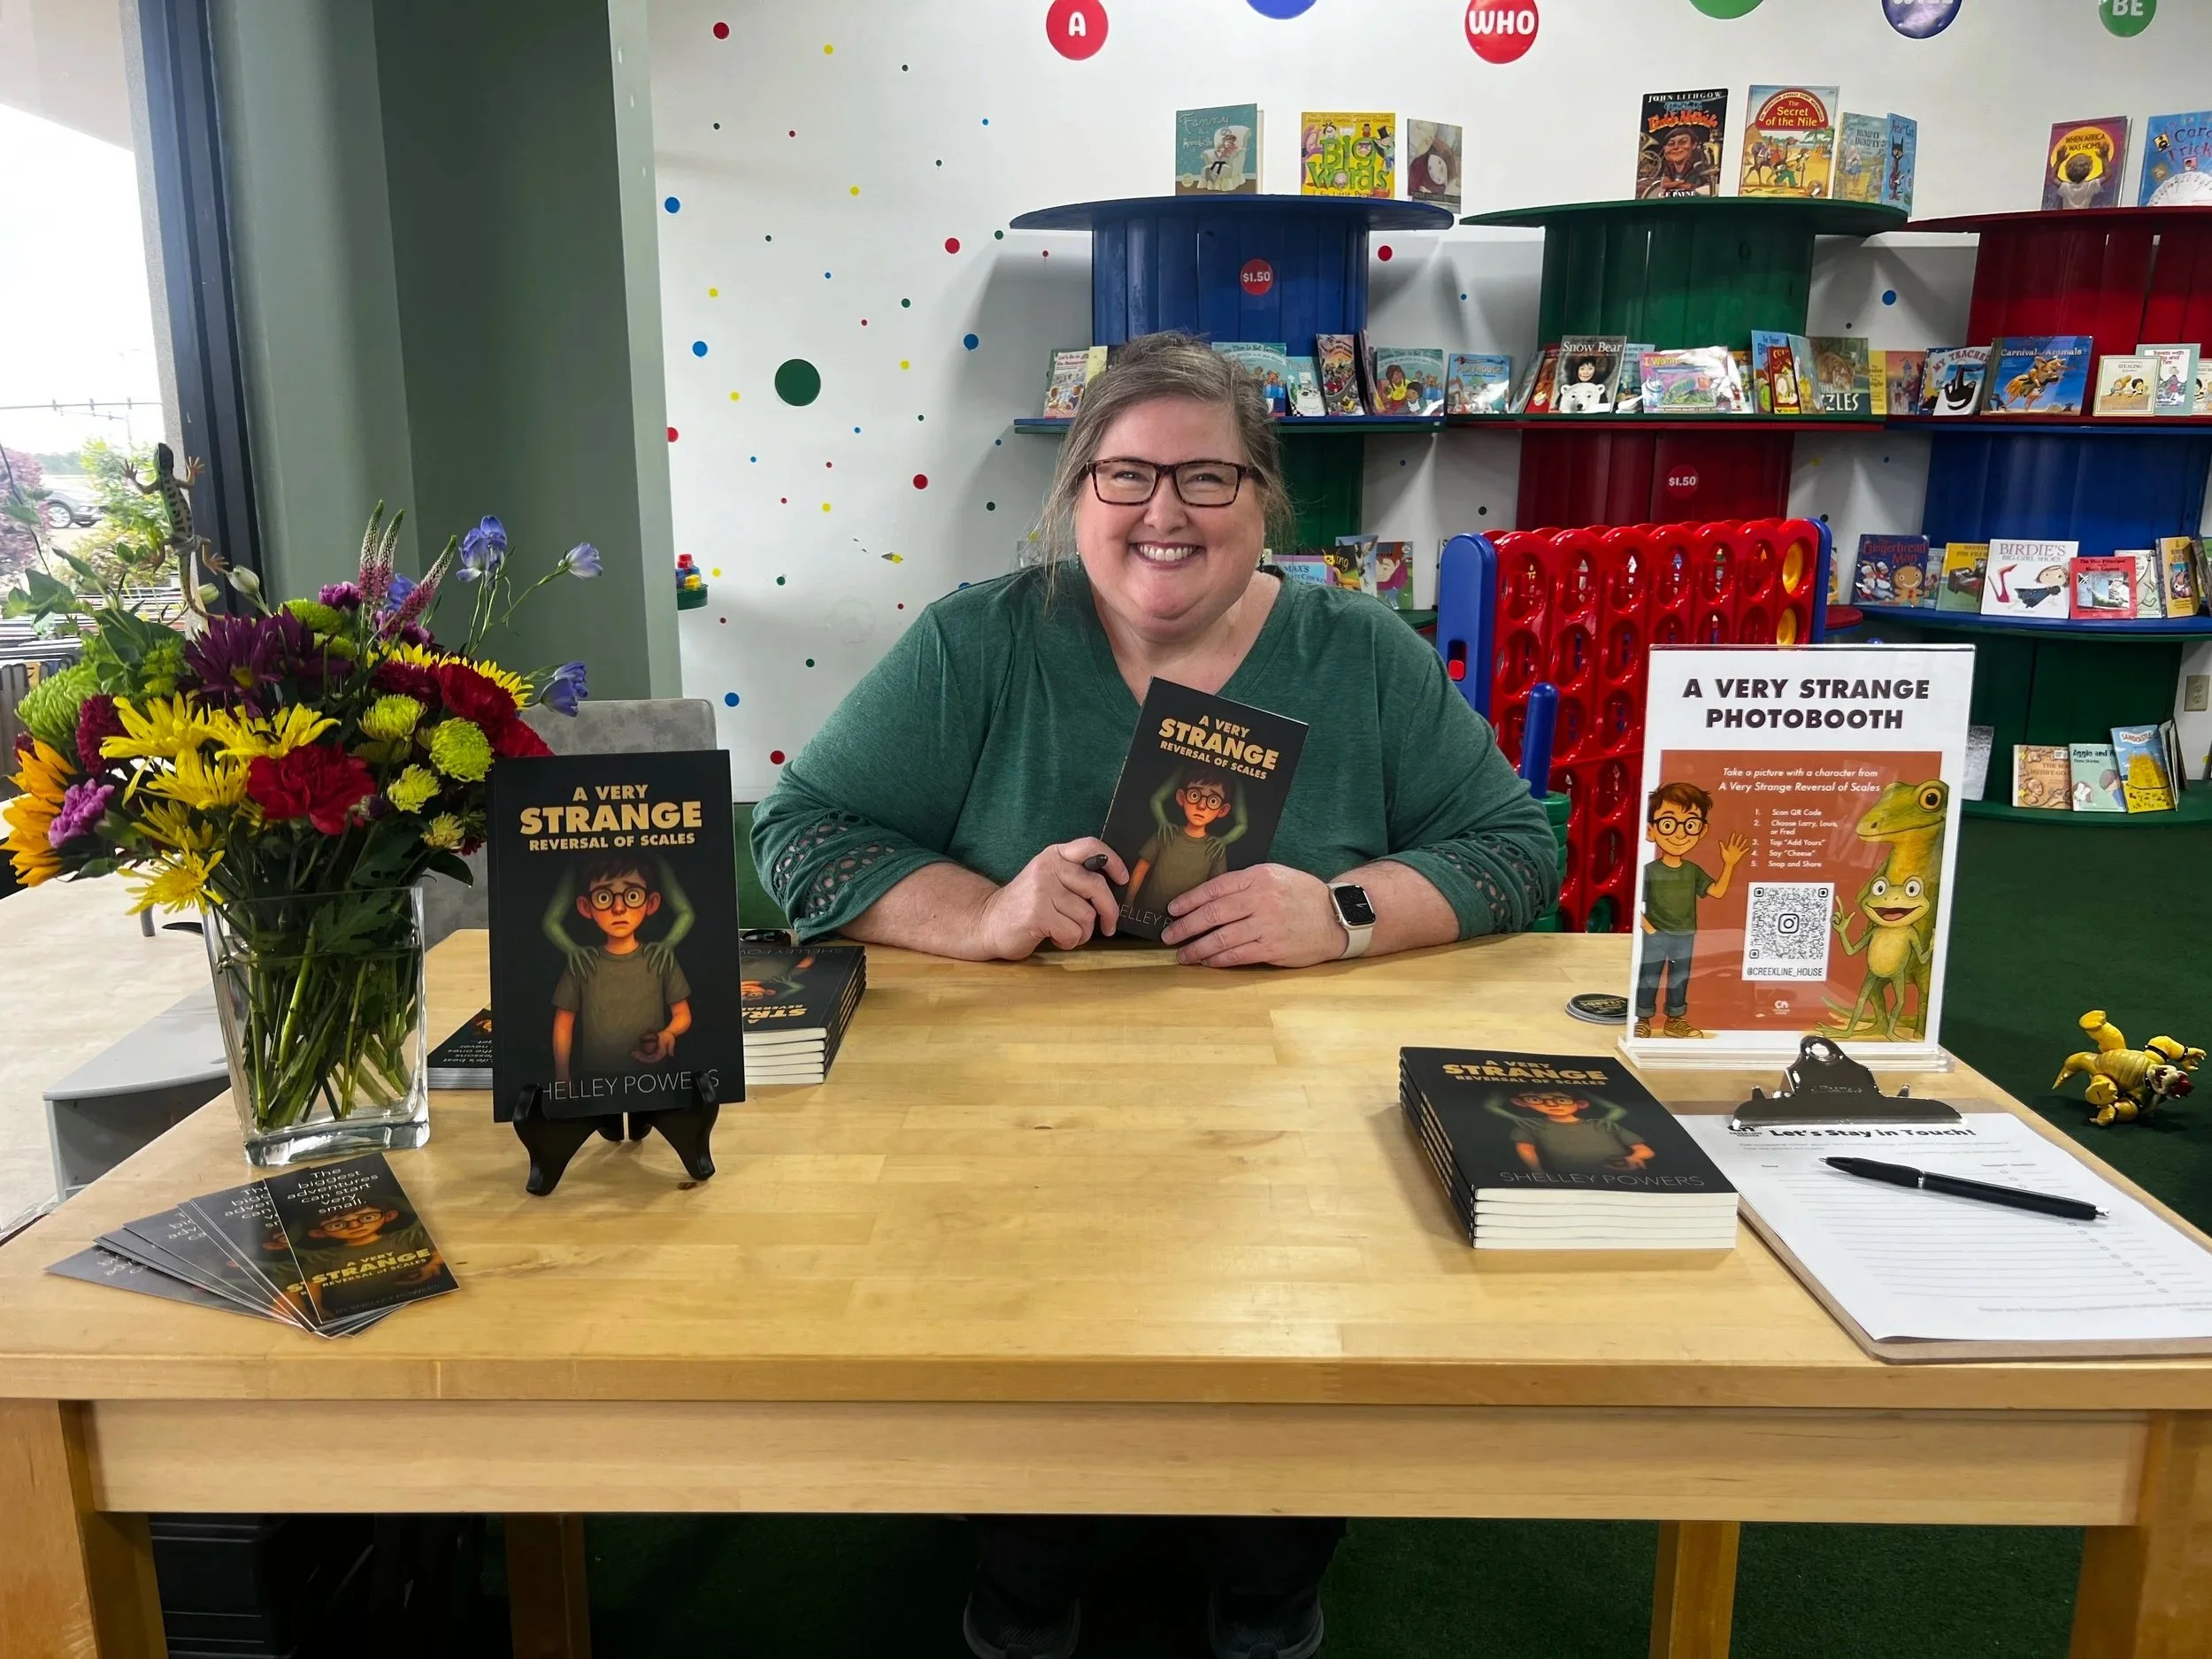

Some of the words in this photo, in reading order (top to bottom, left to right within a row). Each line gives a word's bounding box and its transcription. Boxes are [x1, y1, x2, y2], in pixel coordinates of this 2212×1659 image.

[2112, 0, 2144, 16] BE
[1068, 12, 1087, 37] A
[1469, 10, 1535, 35] WHO
[1677, 91, 1723, 101] LITHGOW
[1777, 106, 1809, 117] Secret
[1179, 112, 1230, 134] Fanny
[1765, 117, 1777, 127] of
[1778, 117, 1795, 127] the
[1797, 118, 1817, 127] Nile
[2065, 134, 2084, 143] WHEN
[2085, 133, 2106, 142] AFRICA
[1320, 134, 1377, 169] Big
[1307, 161, 1389, 190] Words
[1242, 271, 1271, 282] $1.50
[1563, 341, 1594, 353] Snow
[1597, 341, 1623, 353] Bear
[2001, 348, 2038, 357] Carnival
[2045, 348, 2083, 357] Animals
[1932, 358, 1946, 372] MY
[1949, 349, 1991, 364] TEACHER
[1669, 475, 1696, 487] $1.50
[1863, 540, 1926, 556] Gingerbread
[2000, 542, 2065, 557] BIRDIE'S
[1892, 552, 1918, 564] Man
[1682, 679, 1703, 699] A
[1715, 679, 1789, 699] VERY
[1799, 679, 1930, 700] STRANGE
[1198, 715, 1210, 727] A
[1215, 718, 1251, 738] VERY
[1706, 708, 1903, 729] PHOTOBOOTH
[1158, 718, 1279, 771] STRANGE
[2120, 732, 2152, 742] SANDCASTLE
[1160, 740, 1211, 764] REVERSAL
[1213, 757, 1228, 769] OF
[1230, 763, 1267, 780] SCALES
[1723, 767, 1743, 777] Take
[1753, 767, 1785, 779] picture
[1786, 767, 1804, 777] with
[1815, 767, 1855, 777] character
[1858, 767, 1878, 777] from
[572, 787, 588, 802] A
[595, 784, 649, 801] VERY
[1718, 782, 1727, 791] A
[1730, 782, 1752, 794] Very
[1755, 781, 1792, 794] Strange
[1794, 782, 1835, 792] Reversal
[1838, 781, 1849, 792] of
[1850, 782, 1880, 792] Scales
[519, 801, 703, 835] STRANGE
[529, 836, 609, 851] REVERSAL
[614, 835, 634, 847] OF
[641, 833, 695, 847] SCALES
[1770, 839, 1782, 848] Tap
[1769, 849, 1782, 858] Say
[1768, 860, 1786, 869] Snap
[1117, 902, 1163, 927] ELLEY
[1747, 966, 1824, 977] @CREEKLINE_HOUSE
[1442, 1064, 1609, 1080] STRANGE
[1502, 1060, 1551, 1069] VERY
[541, 1076, 618, 1101] HELLEY
[624, 1069, 720, 1094] POWES
[1824, 1129, 1872, 1138] Stay
[297, 1169, 362, 1189] biggest
[310, 1168, 342, 1179] The
[1500, 1171, 1595, 1183] SHELLEY
[1601, 1174, 1706, 1187] POWERS
[287, 1173, 379, 1200] adventures
[301, 1193, 330, 1203] can
[335, 1182, 372, 1195] start
[319, 1198, 367, 1215] small.
[321, 1194, 357, 1206] very
[360, 1250, 395, 1263] VERY
[311, 1248, 432, 1284] STRANGE
[322, 1271, 374, 1287] REVERSAL
[390, 1257, 427, 1271] SCALES
